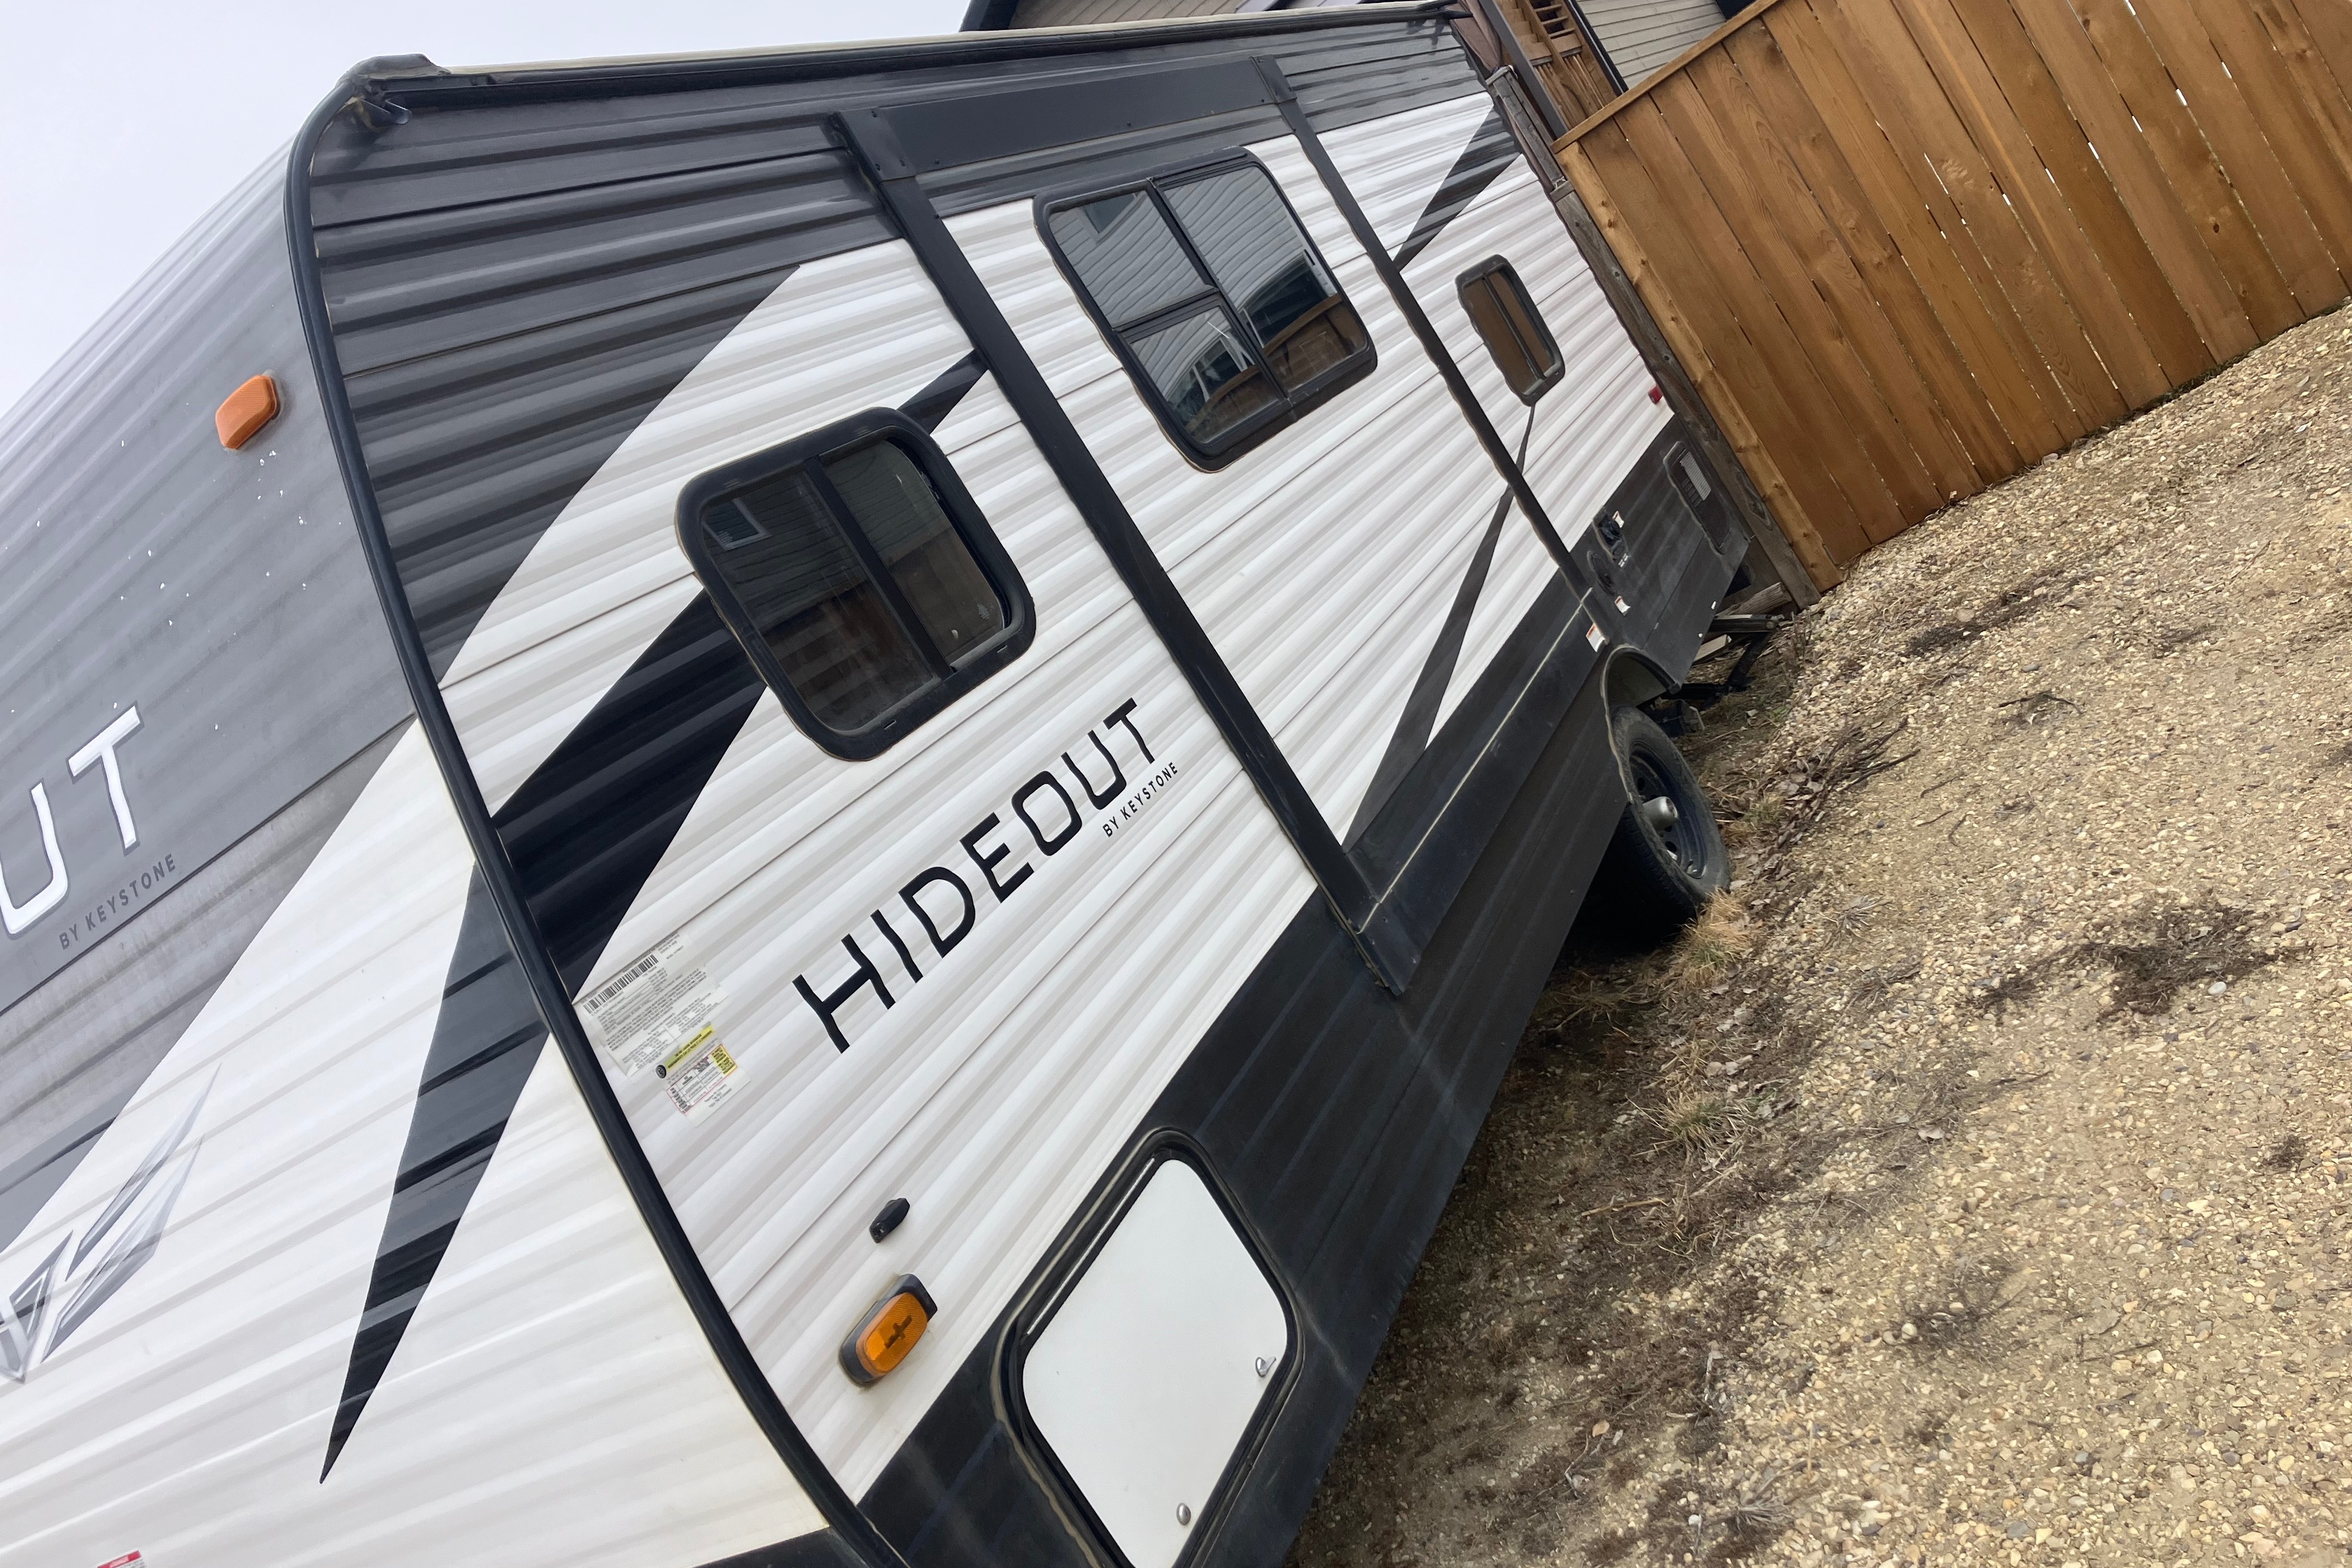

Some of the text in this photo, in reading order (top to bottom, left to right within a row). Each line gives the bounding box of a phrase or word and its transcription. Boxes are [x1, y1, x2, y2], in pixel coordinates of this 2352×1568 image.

[1102, 762, 1178, 837] BY KEYSTONE
[59, 853, 176, 950] BY KEYSTONE
[792, 698, 1155, 1054] HIDEOUT
